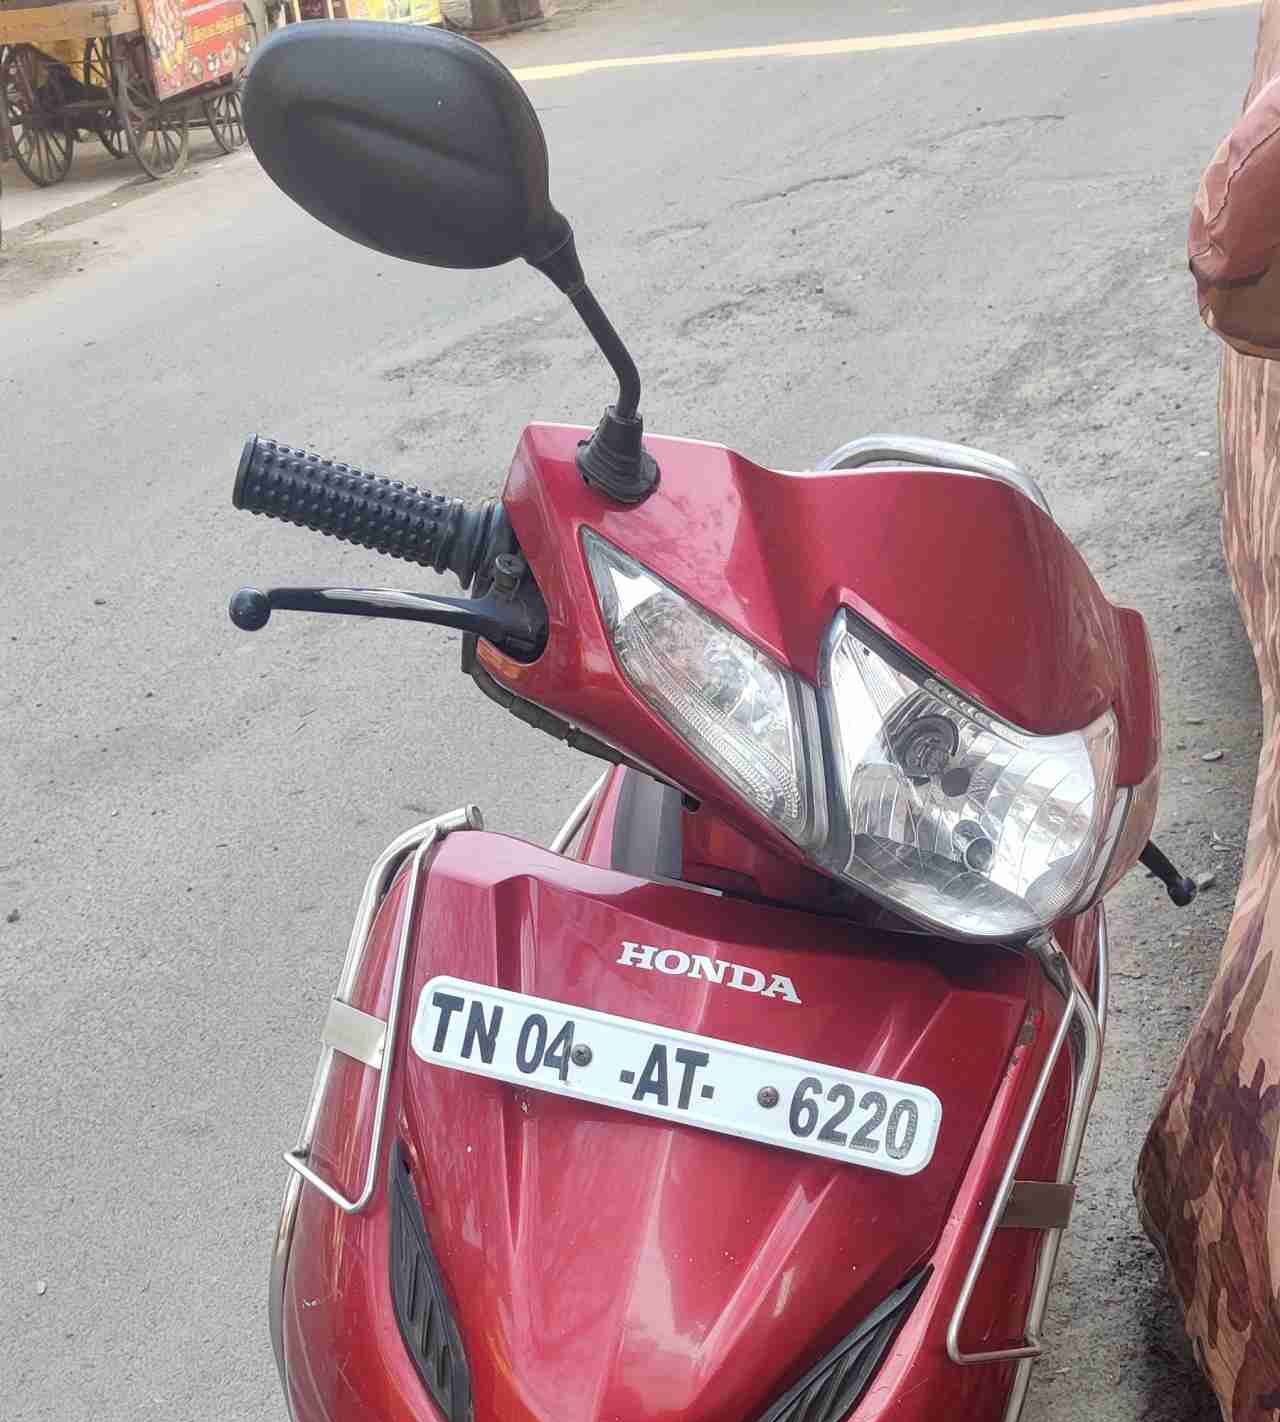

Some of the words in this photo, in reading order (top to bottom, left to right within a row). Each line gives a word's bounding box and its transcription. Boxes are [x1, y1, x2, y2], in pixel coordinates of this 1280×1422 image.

[616, 940, 802, 1004] HONDA
[431, 991, 504, 1065] TN
[515, 1013, 576, 1081] 04
[788, 1076, 918, 1160] 6220
